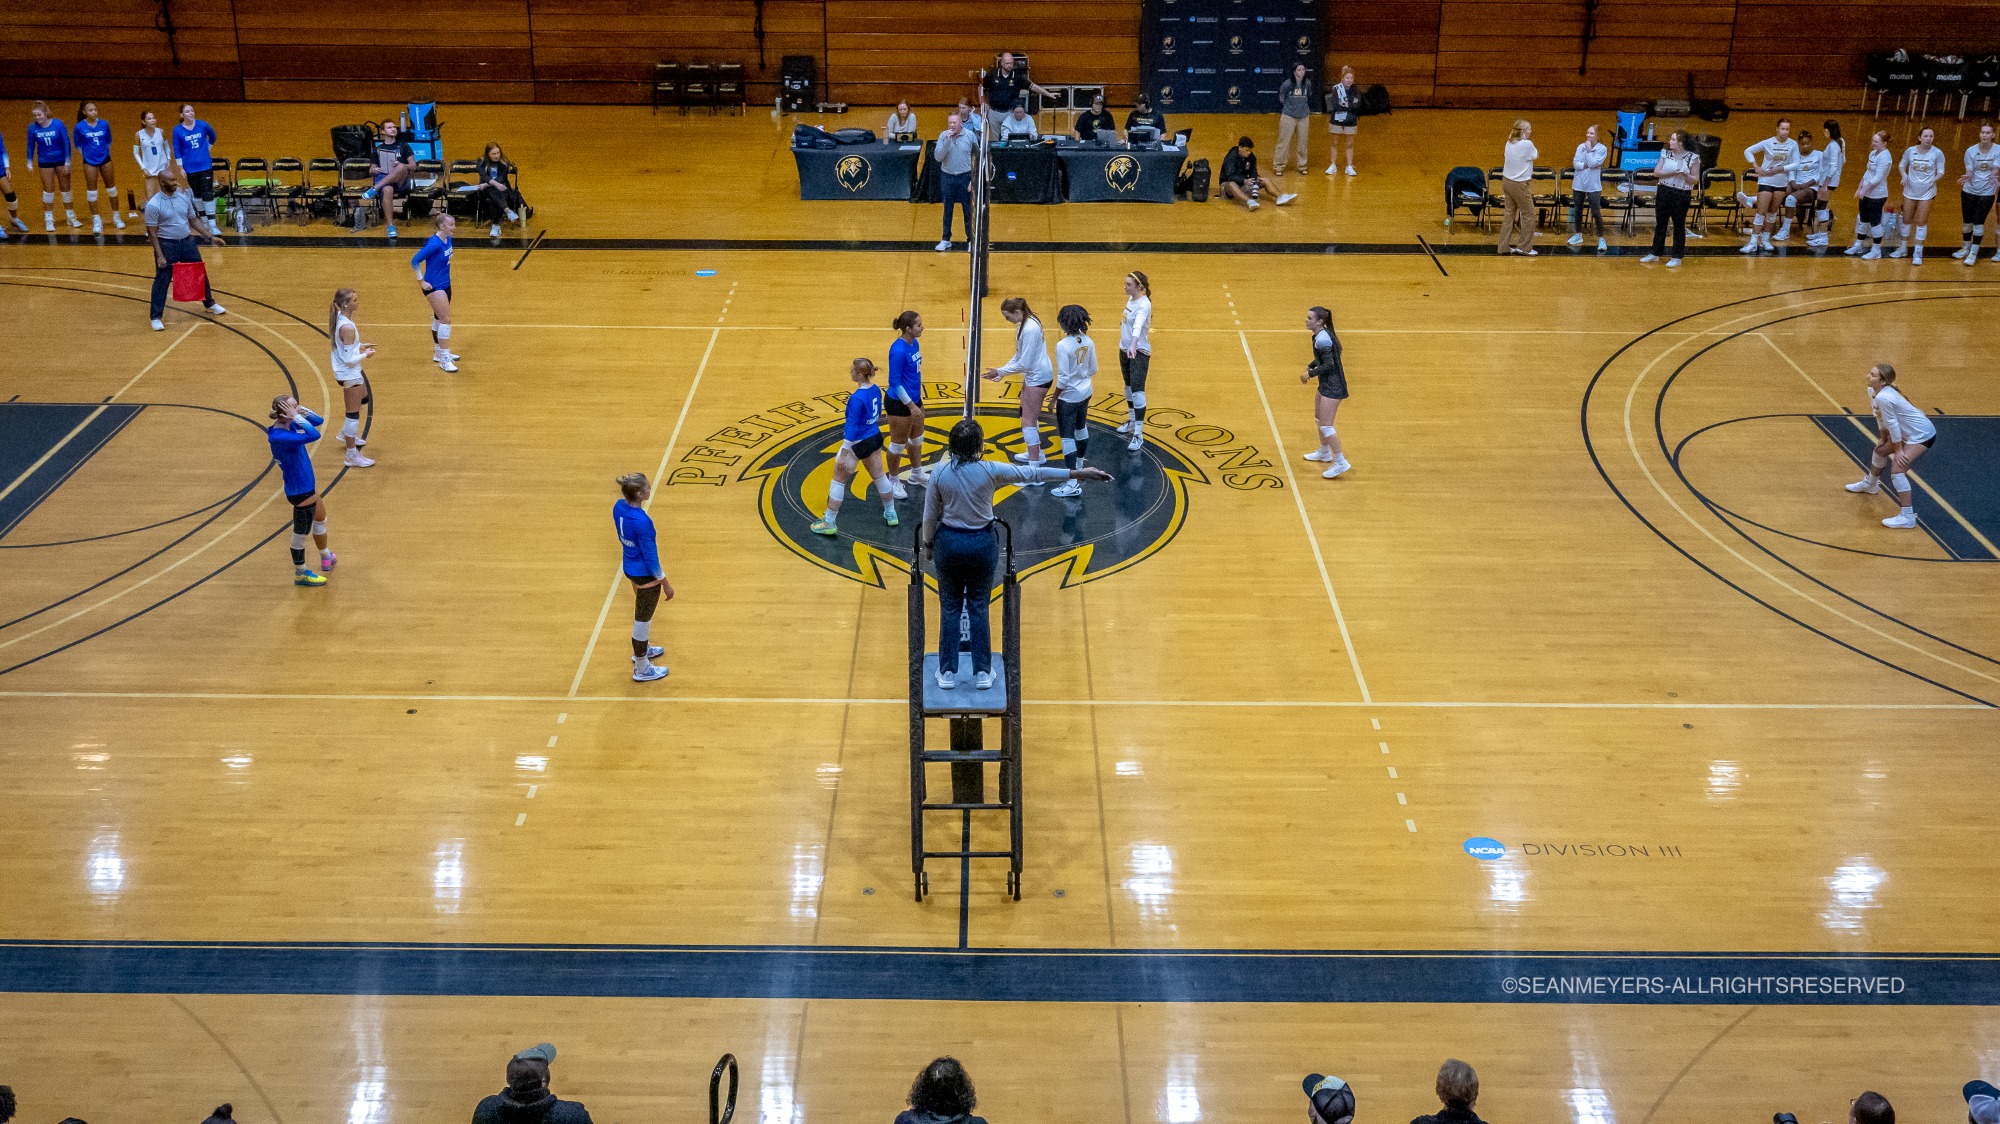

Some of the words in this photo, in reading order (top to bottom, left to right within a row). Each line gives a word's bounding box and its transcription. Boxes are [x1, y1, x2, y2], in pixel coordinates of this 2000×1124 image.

[43, 137, 52, 146] 11
[1074, 345, 1089, 366] 17
[871, 397, 879, 417] 5
[666, 381, 967, 487] PFEIFFR
[998, 380, 1285, 491] FLCONS
[1468, 847, 1505, 855] NCAA
[1522, 842, 1650, 858] DIVISION
[1659, 845, 1683, 858] III
